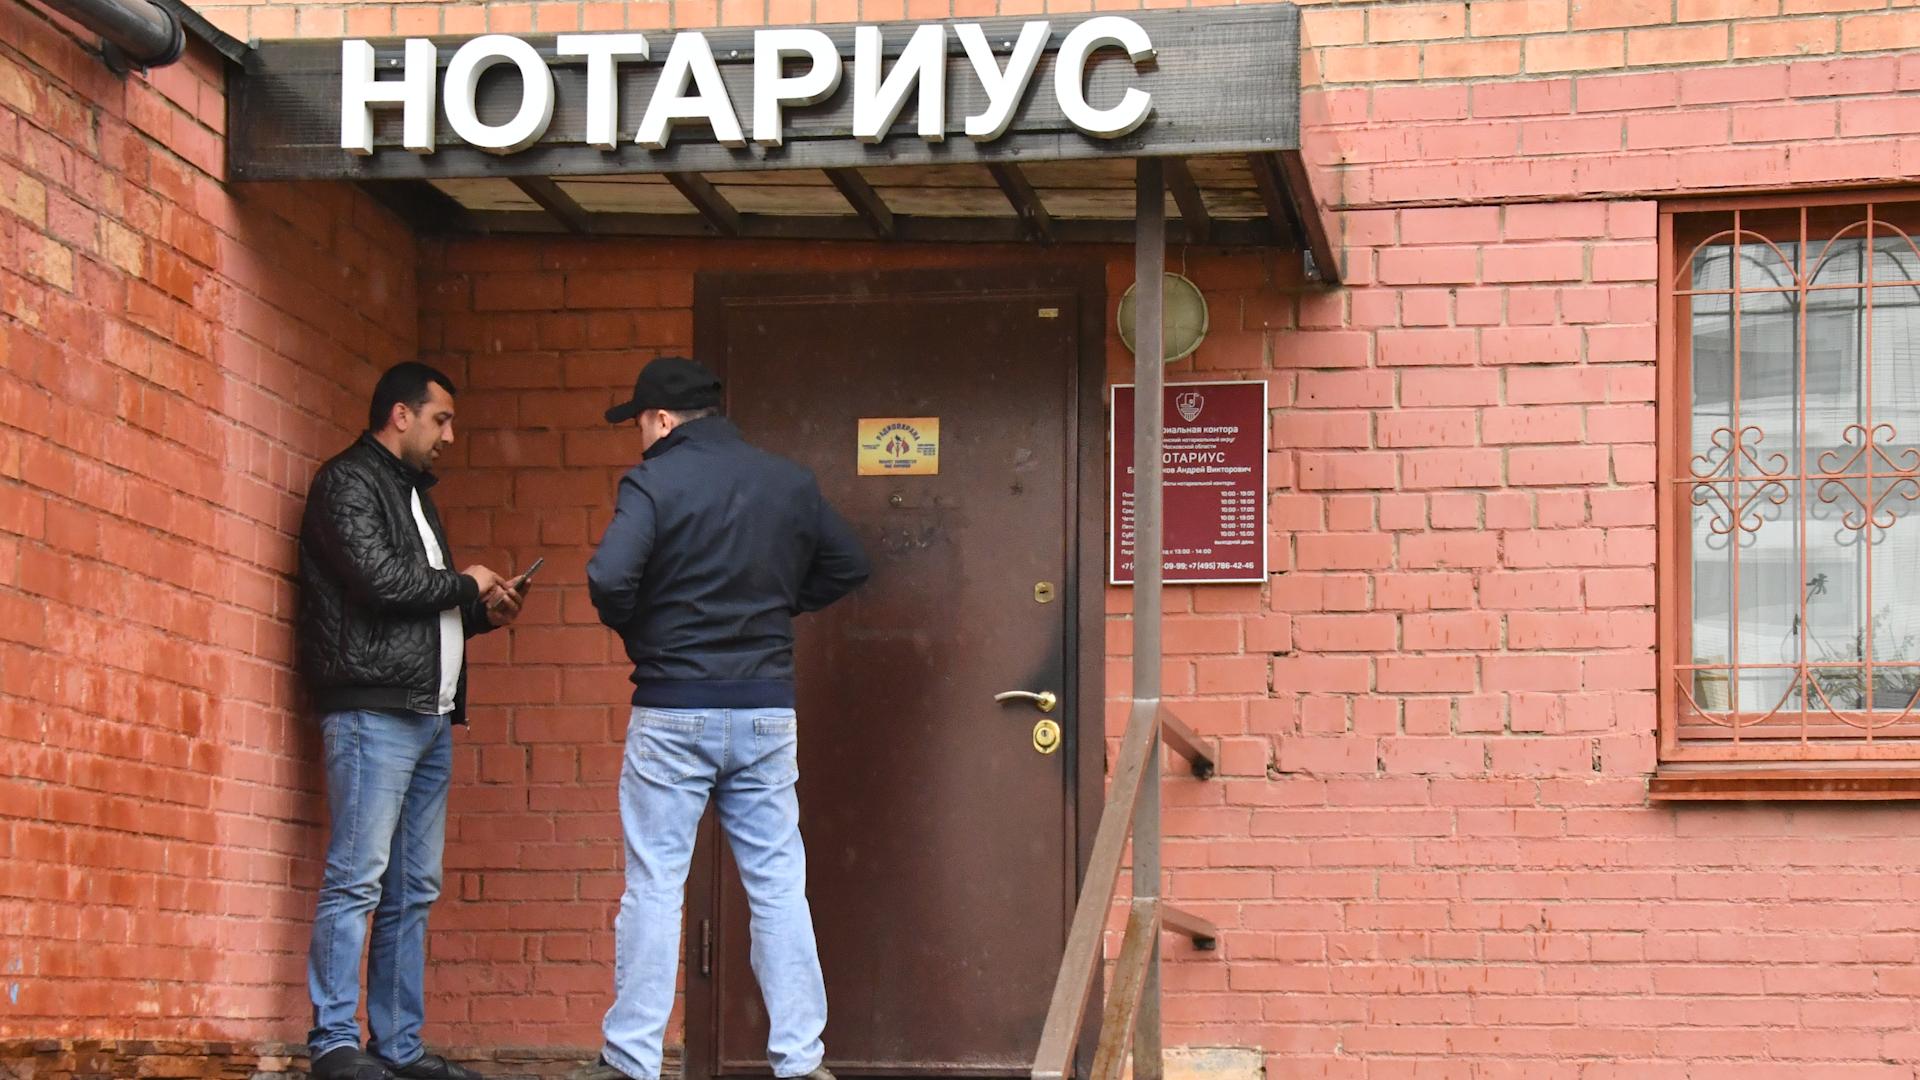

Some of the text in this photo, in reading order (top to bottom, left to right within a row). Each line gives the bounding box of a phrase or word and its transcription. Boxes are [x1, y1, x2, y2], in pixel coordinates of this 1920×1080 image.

[340, 16, 1155, 156] НОТАРИУС
[1162, 426, 1239, 435] риальная контора
[1162, 451, 1225, 464] ОТАРИУС
[1176, 466, 1205, 475] Андрей
[1206, 465, 1252, 475] Викторович
[1197, 561, 1216, 571] (495)
